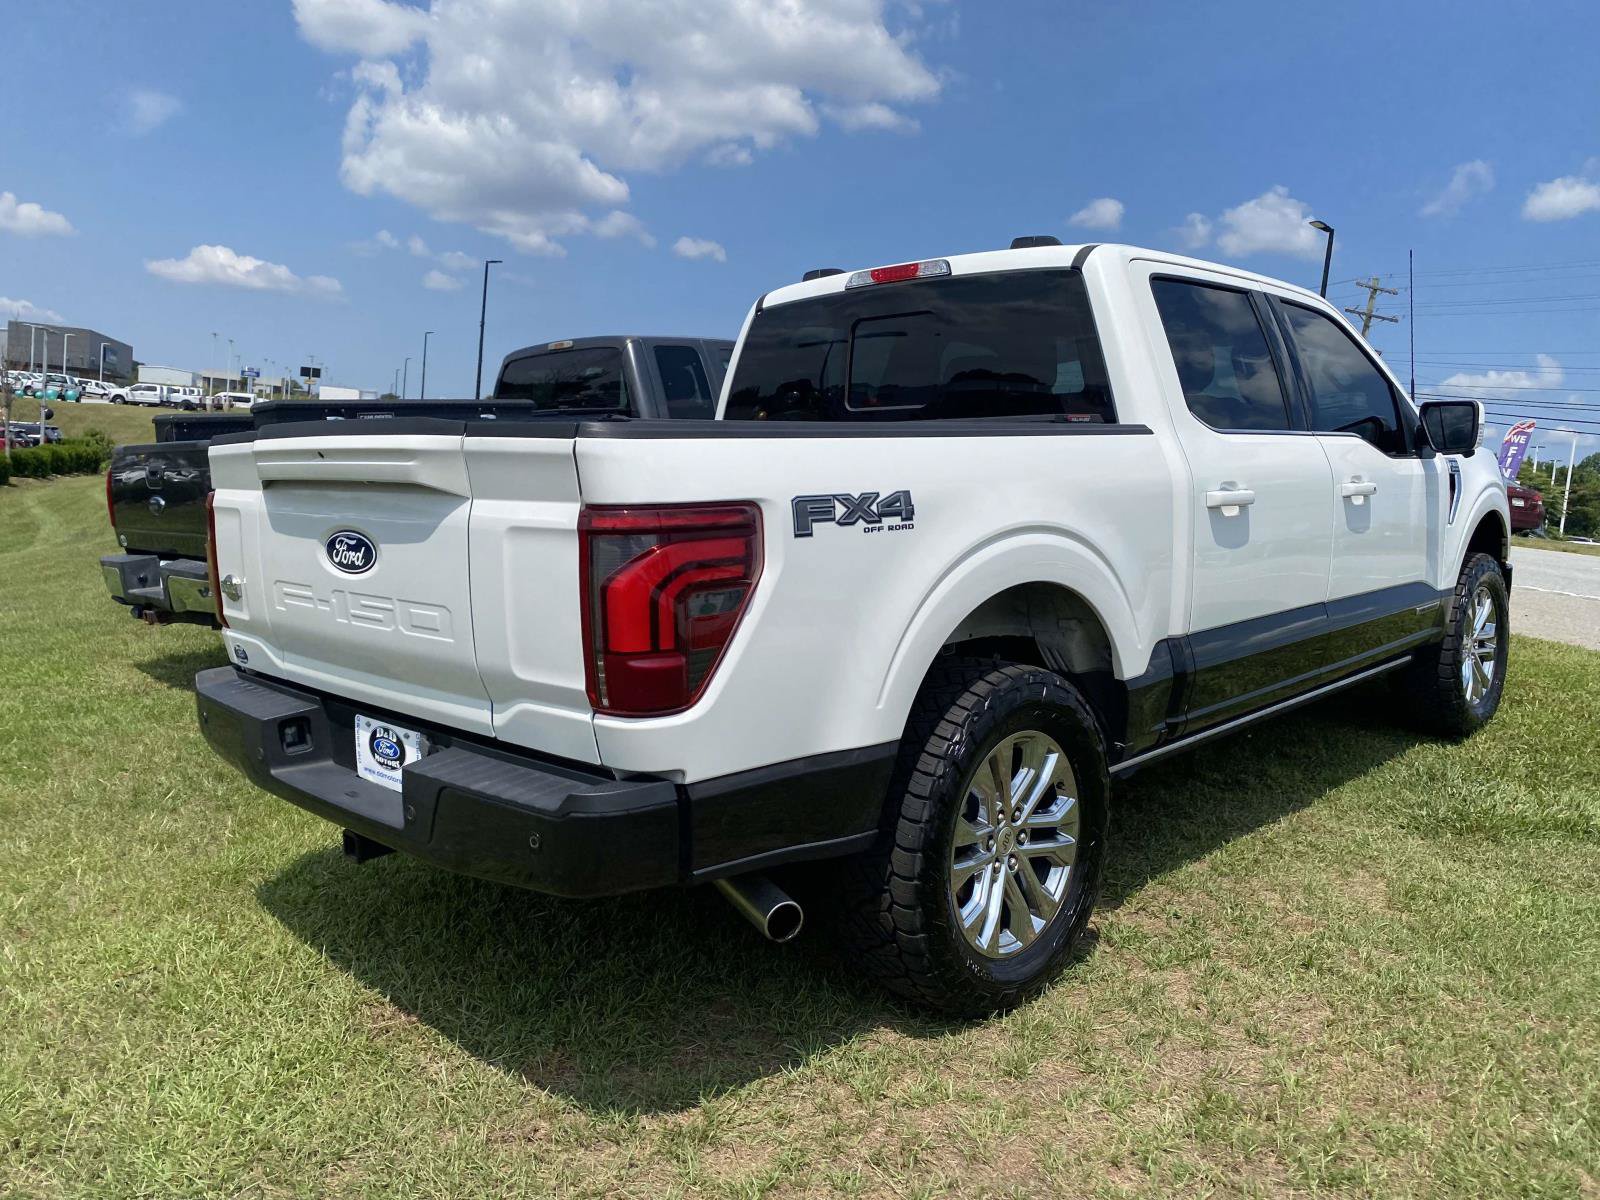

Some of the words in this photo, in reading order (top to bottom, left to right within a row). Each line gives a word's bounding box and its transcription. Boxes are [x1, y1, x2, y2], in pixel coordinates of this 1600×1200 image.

[1510, 434, 1527, 444] WE
[791, 490, 915, 539] FX4
[863, 525, 885, 534] OFF
[887, 523, 915, 532] ROAD
[332, 536, 365, 567] Ford
[273, 579, 455, 643] F-150
[376, 727, 397, 743] D&D
[378, 740, 396, 757] Ford
[374, 753, 400, 769] MOTORS
